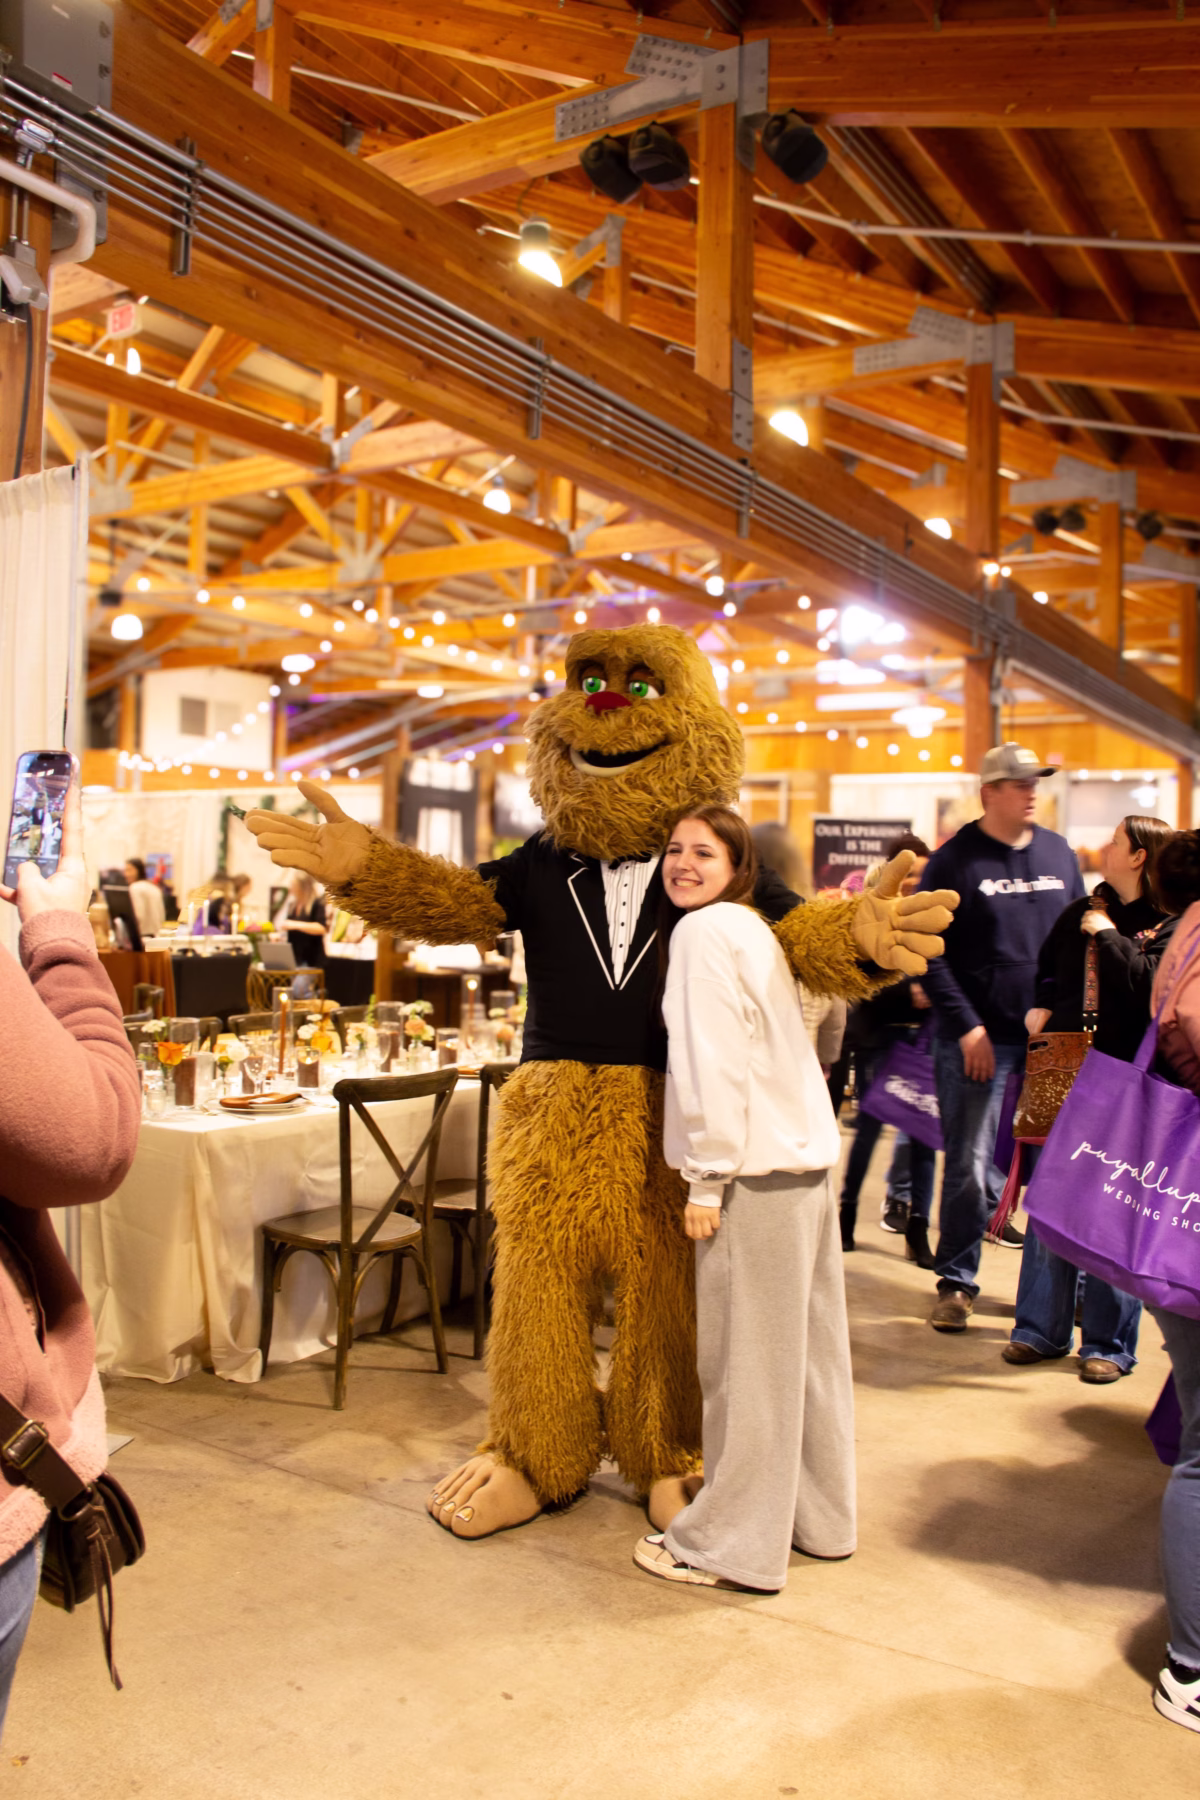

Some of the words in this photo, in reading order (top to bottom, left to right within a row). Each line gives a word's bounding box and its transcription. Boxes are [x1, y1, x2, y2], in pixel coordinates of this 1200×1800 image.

[844, 824, 905, 838] EXPERIEN
[828, 853, 888, 866] DIFFEREN
[1070, 1141, 1200, 1214] puyallup
